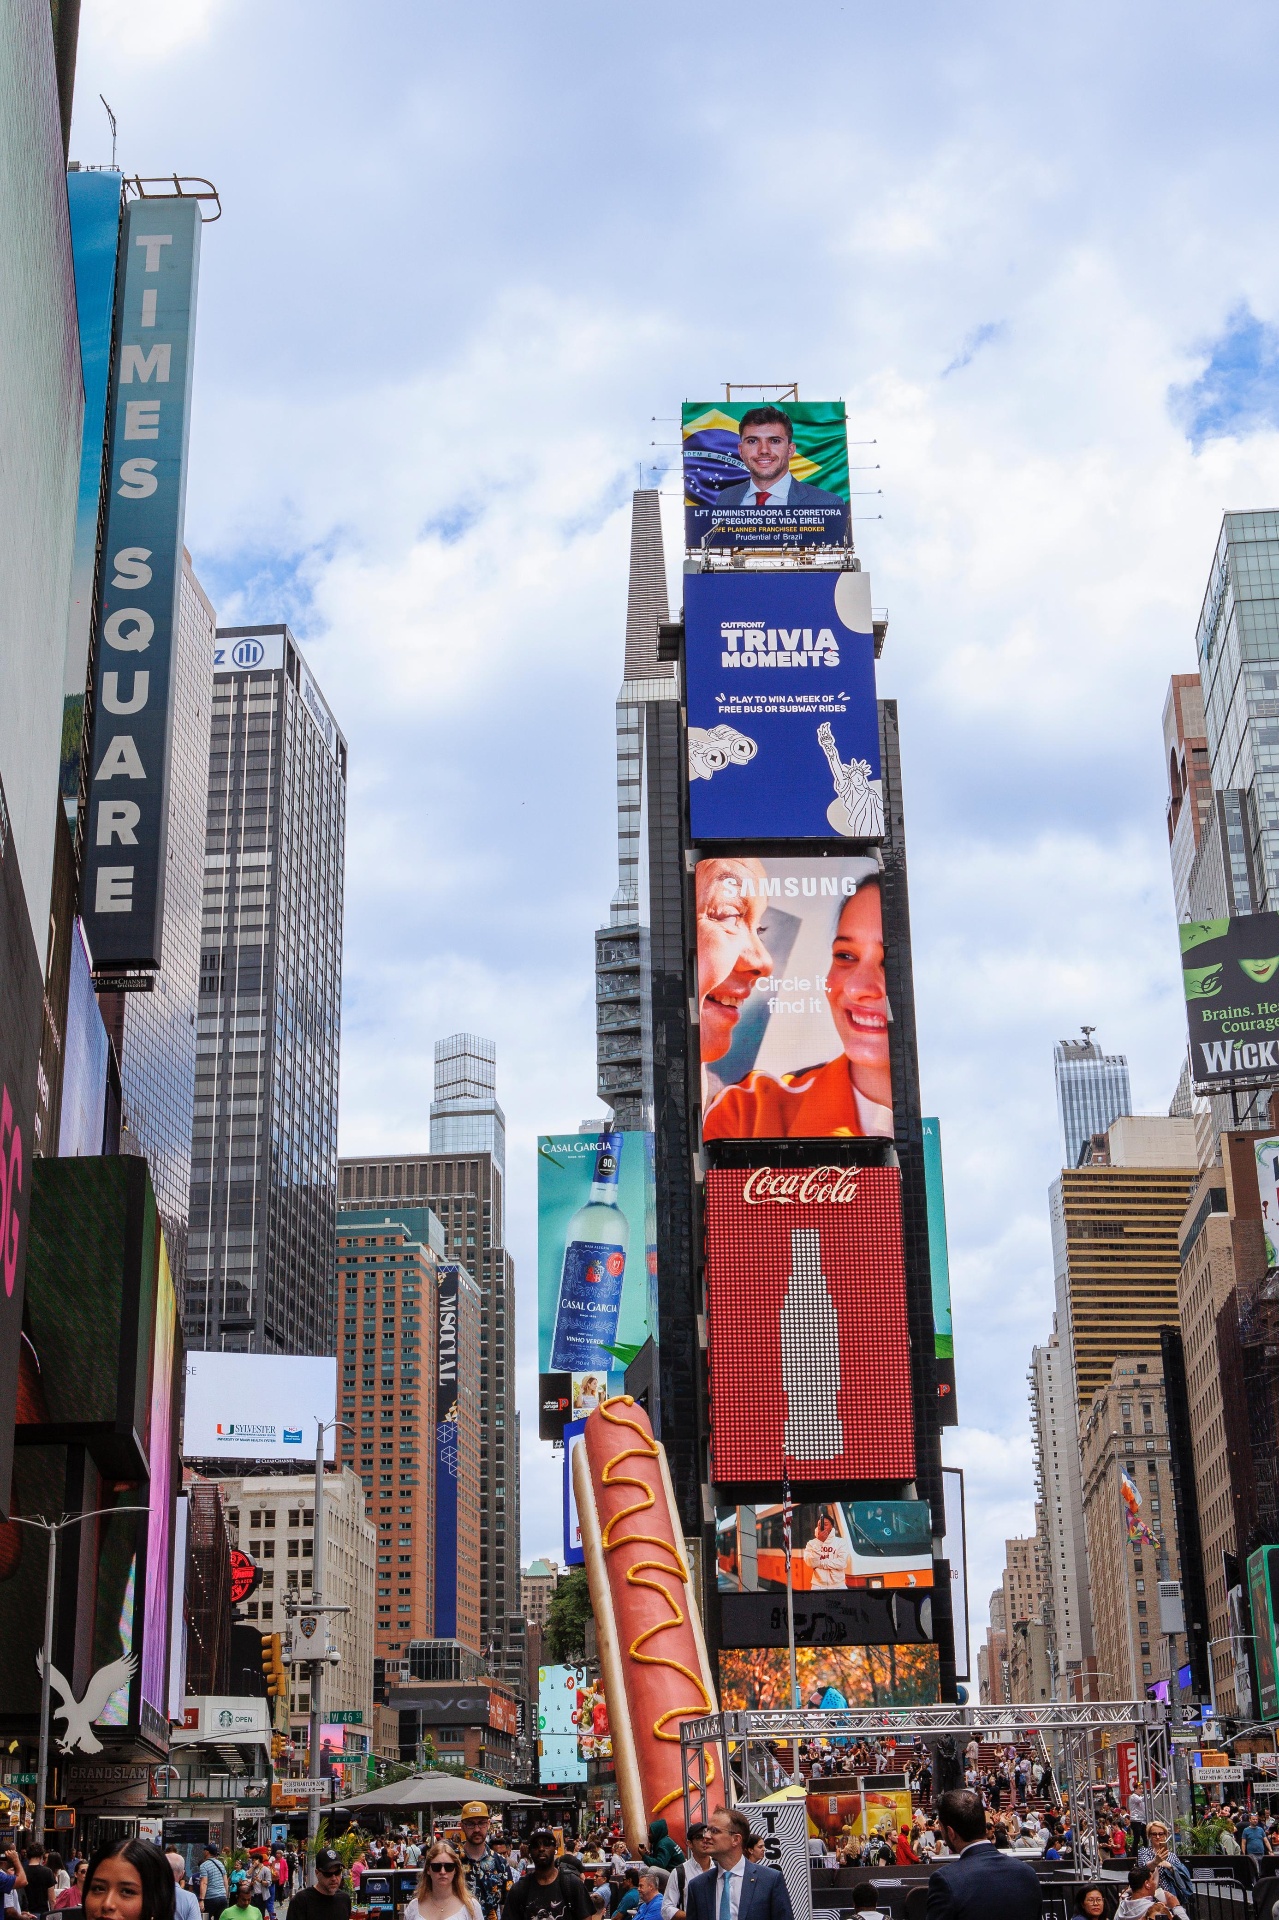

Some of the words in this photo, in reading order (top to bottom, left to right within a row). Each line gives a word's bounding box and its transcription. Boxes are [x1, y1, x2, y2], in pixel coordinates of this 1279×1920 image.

[117, 235, 172, 499] TIMES
[721, 629, 840, 651] TRIVIA
[721, 650, 840, 668] MOMENTS
[95, 547, 154, 912] SQUARE
[722, 876, 857, 897] SAMSUNG
[756, 976, 811, 992] Circle
[816, 975, 832, 993] it,
[767, 998, 804, 1013] find
[809, 998, 822, 1013] it
[1202, 1006, 1254, 1022] Brains.
[1200, 1038, 1279, 1074] WICK
[542, 1144, 573, 1154] CASAL
[574, 1142, 612, 1152] GARCIA
[603, 1158, 612, 1167] 90
[743, 1166, 863, 1204] Coca-Cola
[562, 1299, 585, 1310] CASAL
[587, 1302, 617, 1312] GARCIA
[235, 1424, 276, 1434] SYLVESTER
[331, 1713, 339, 1722] W
[343, 1713, 352, 1722] 46
[12, 1775, 18, 1783] W
[70, 1766, 112, 1779] GRAND
[114, 1767, 148, 1779] SLAM
